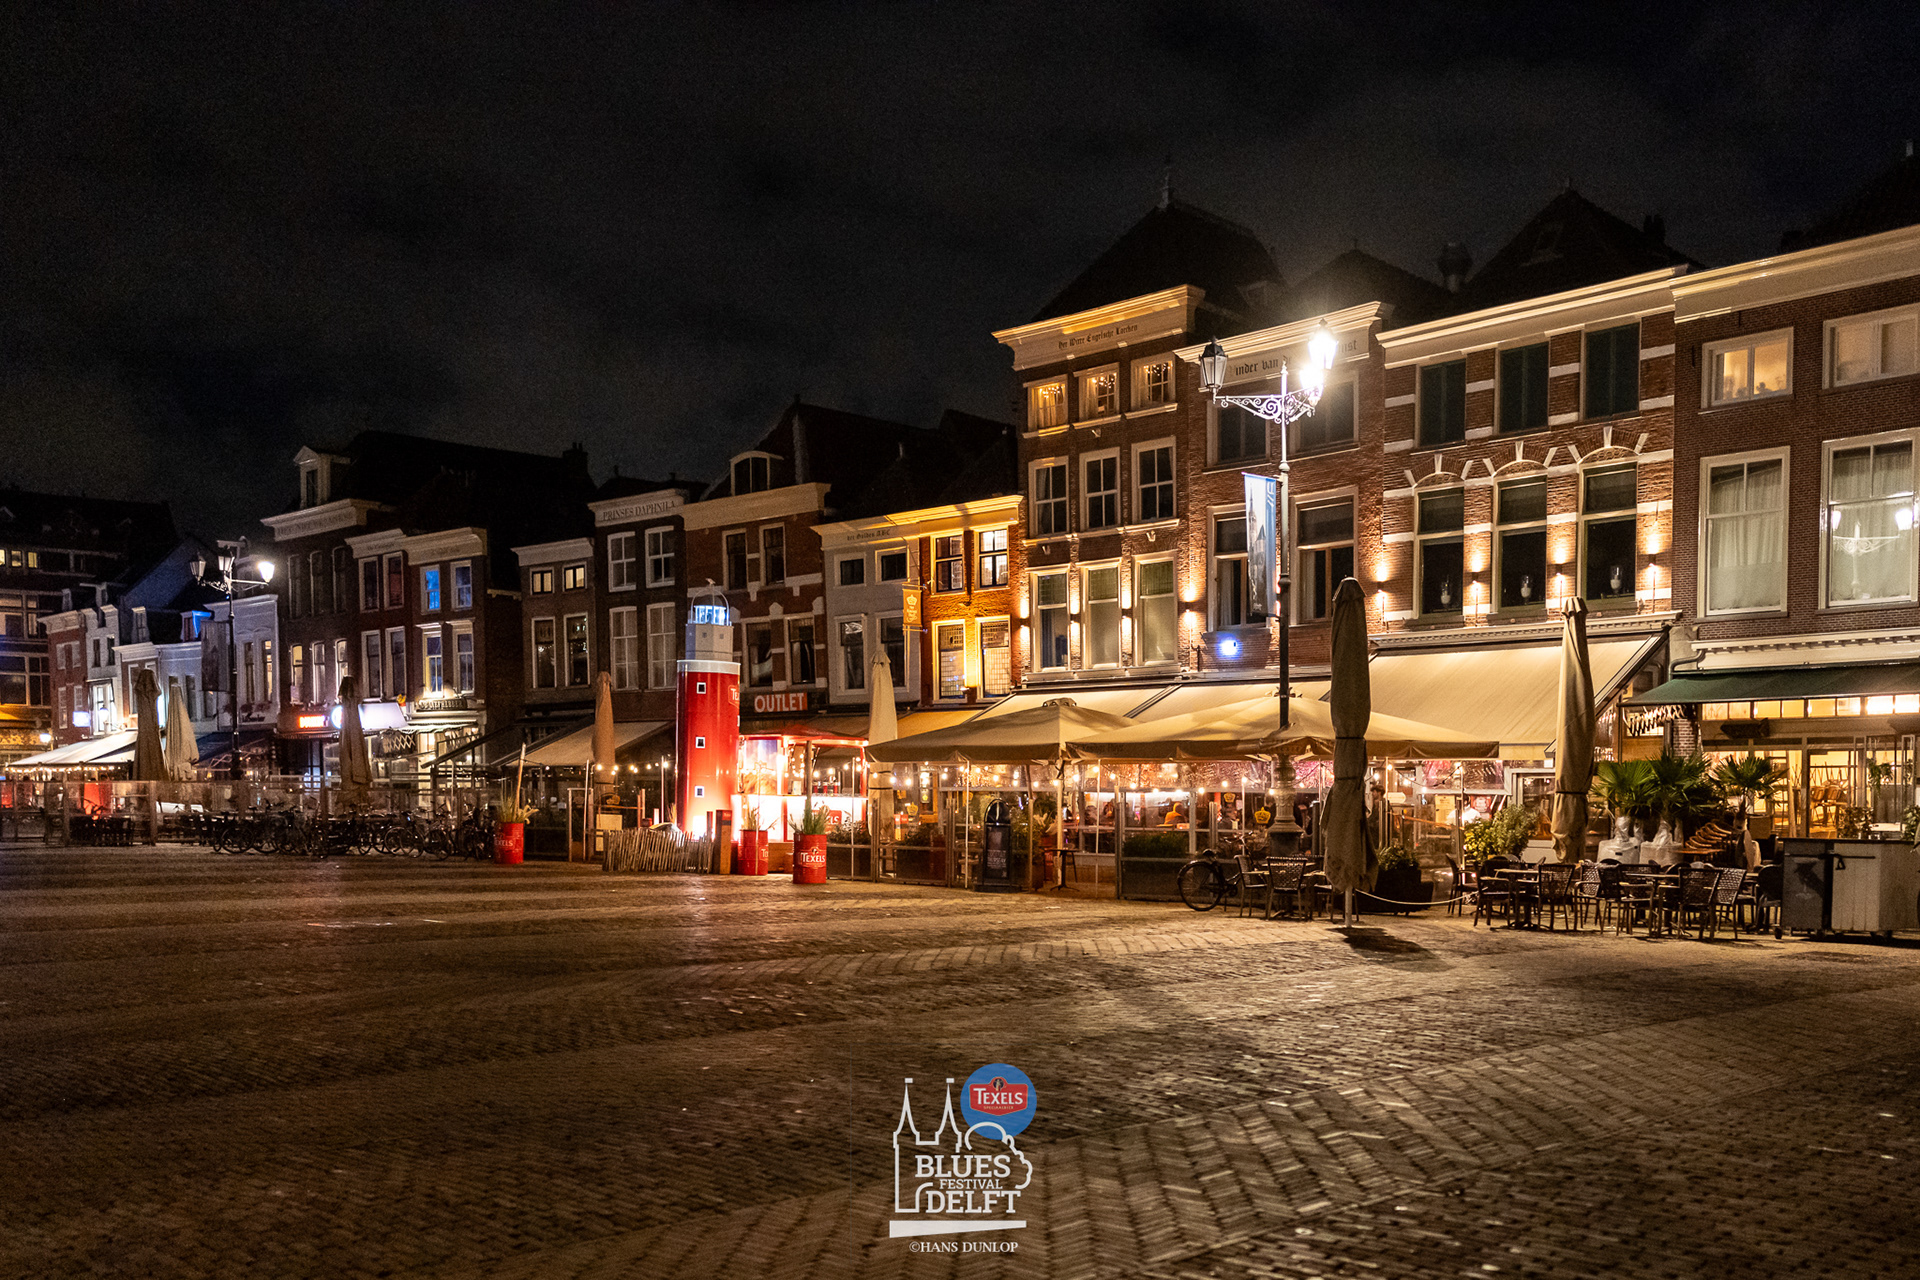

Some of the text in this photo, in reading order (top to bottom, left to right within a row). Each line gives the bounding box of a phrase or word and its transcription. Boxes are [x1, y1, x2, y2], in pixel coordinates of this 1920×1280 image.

[603, 507, 634, 521] PRINSES
[754, 692, 804, 713] OUTLET
[800, 852, 826, 863] TEXELS
